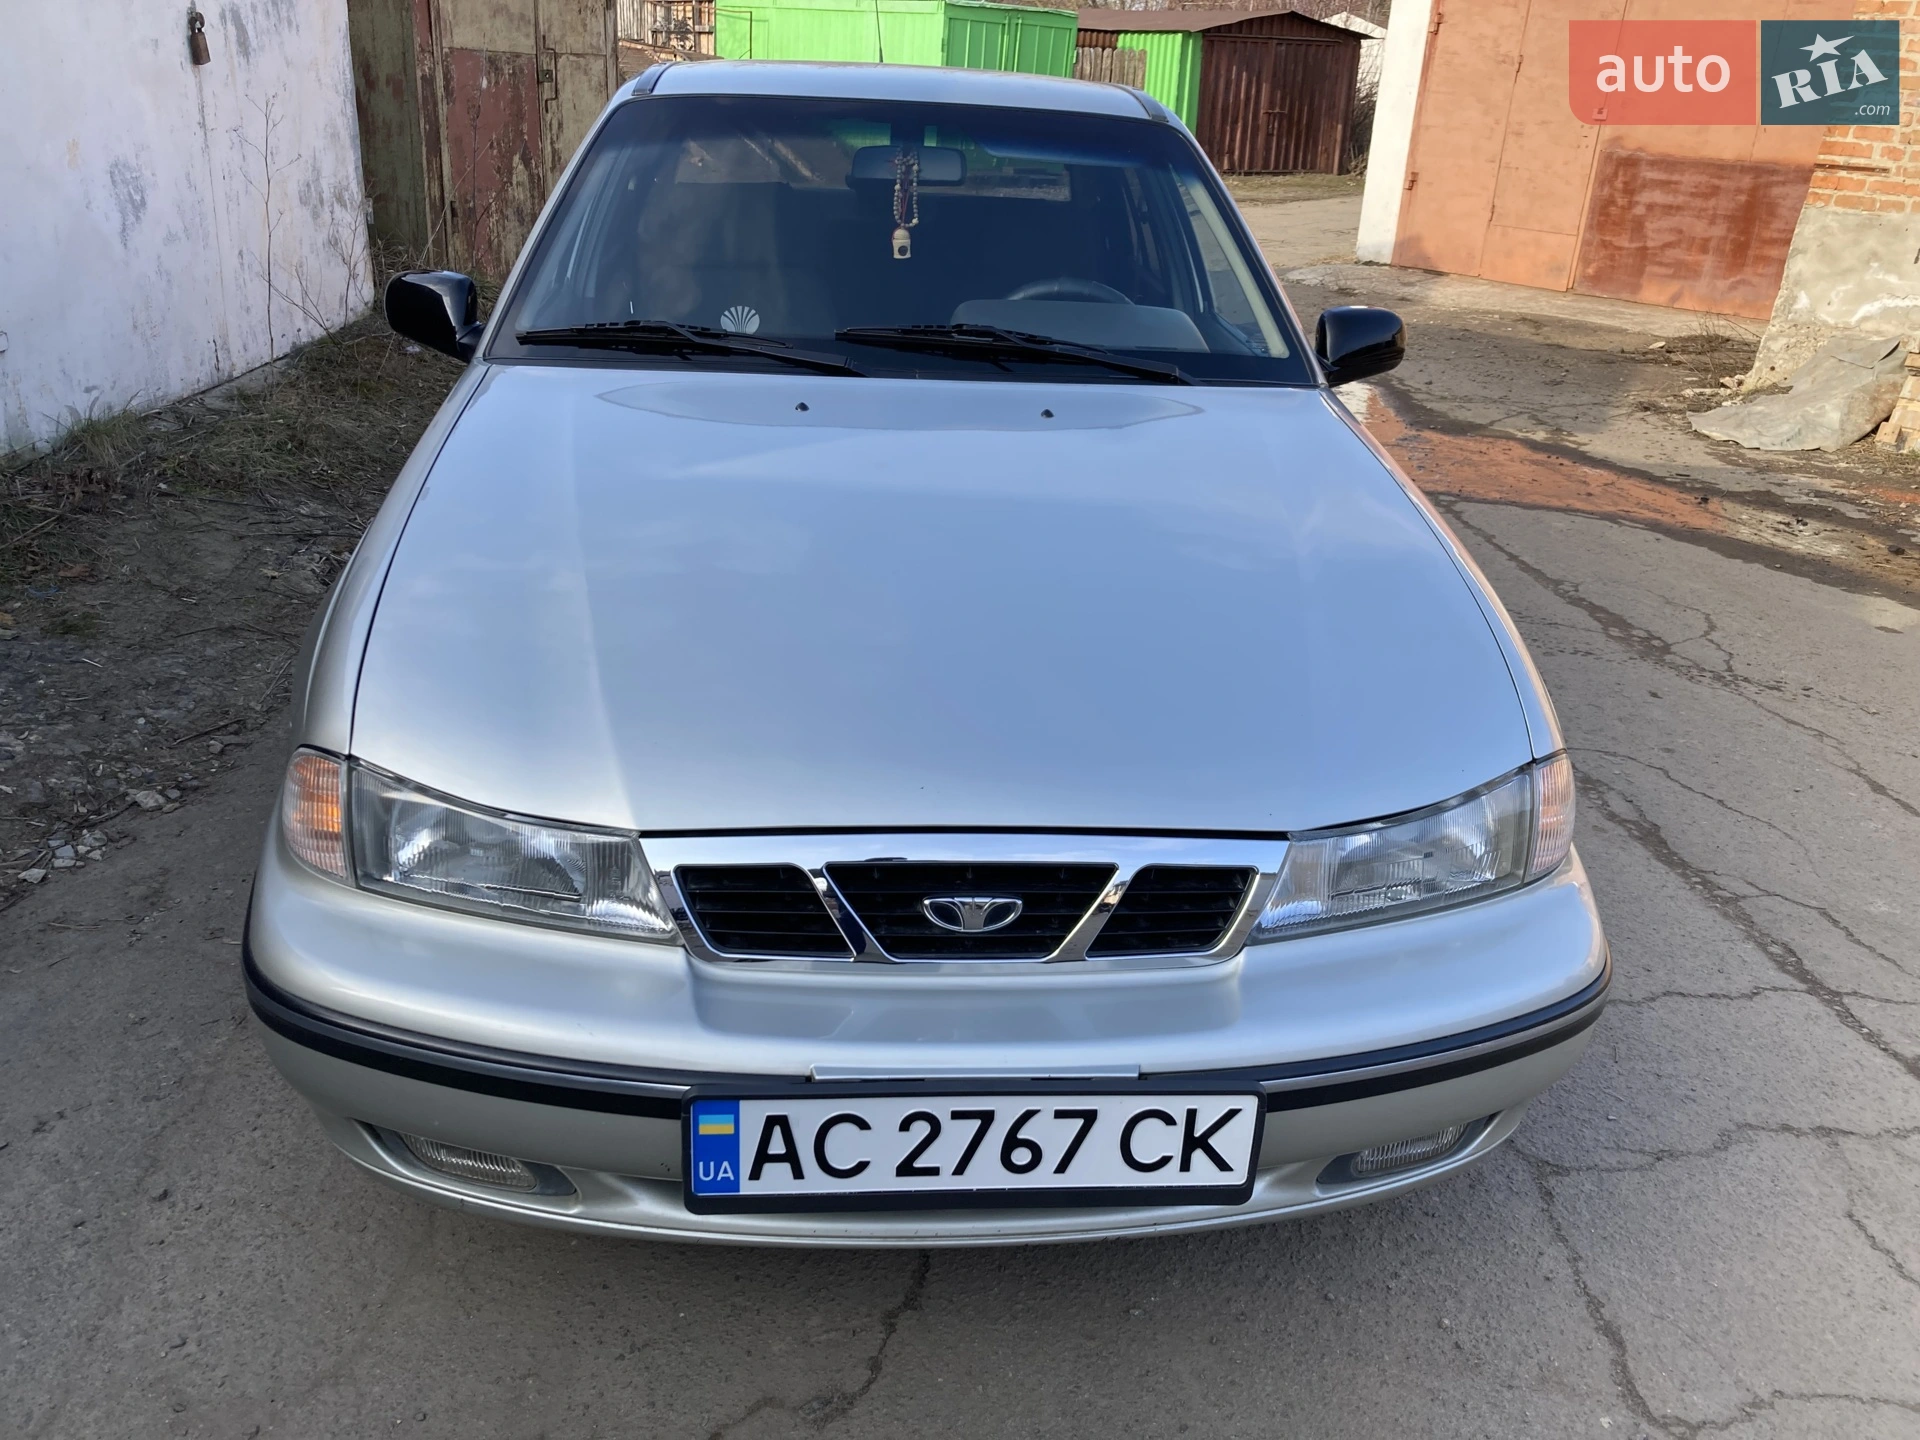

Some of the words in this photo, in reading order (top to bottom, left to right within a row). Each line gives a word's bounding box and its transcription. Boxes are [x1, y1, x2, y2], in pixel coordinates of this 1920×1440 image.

[747, 1112, 872, 1181] AC
[895, 1109, 1098, 1177] 2767
[1119, 1107, 1243, 1174] CK
[699, 1161, 735, 1181] UA
